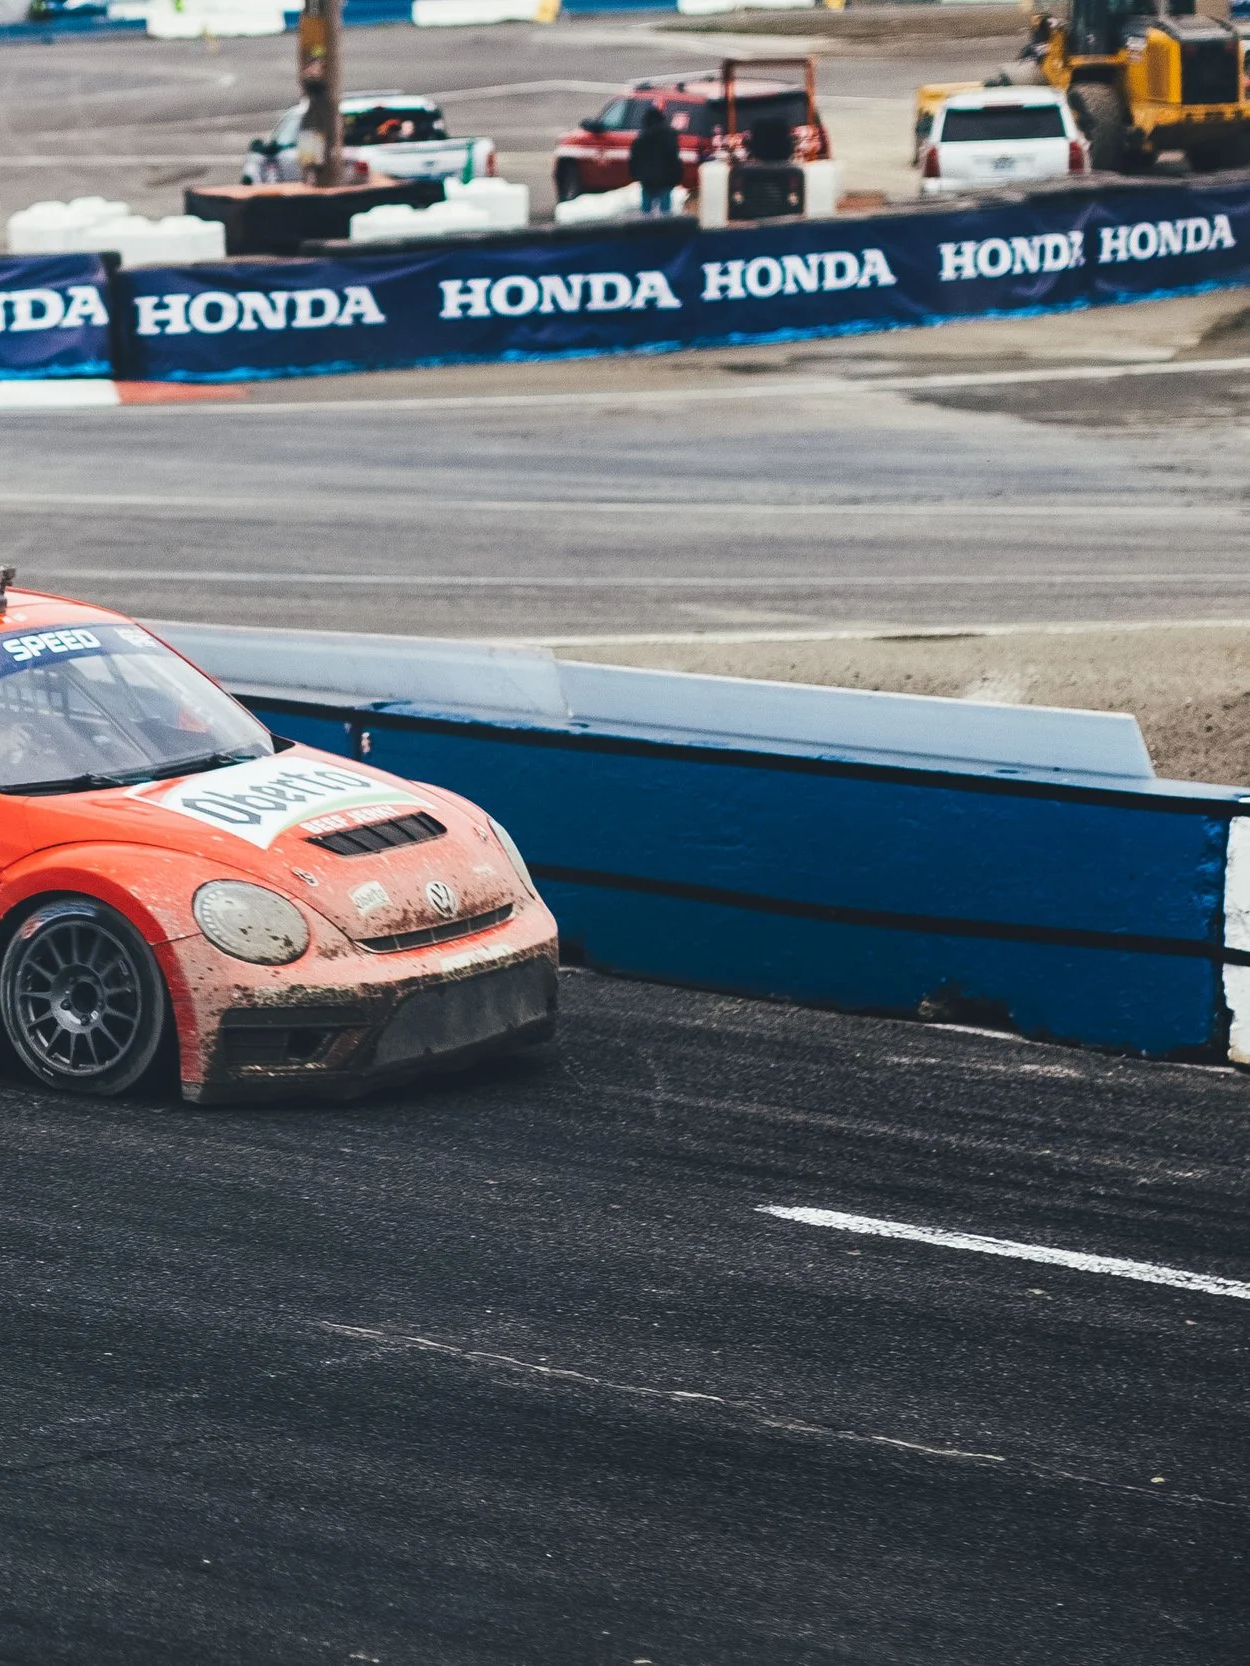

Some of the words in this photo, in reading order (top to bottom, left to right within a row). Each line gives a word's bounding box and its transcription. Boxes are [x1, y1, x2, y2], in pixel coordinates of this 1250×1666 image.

[1098, 214, 1237, 264] HONDA
[439, 271, 682, 319] HONDA
[700, 248, 898, 301] HONDA
[134, 286, 385, 336] HONDA
[2, 628, 102, 662] SPEED
[181, 768, 373, 826] Oberto
